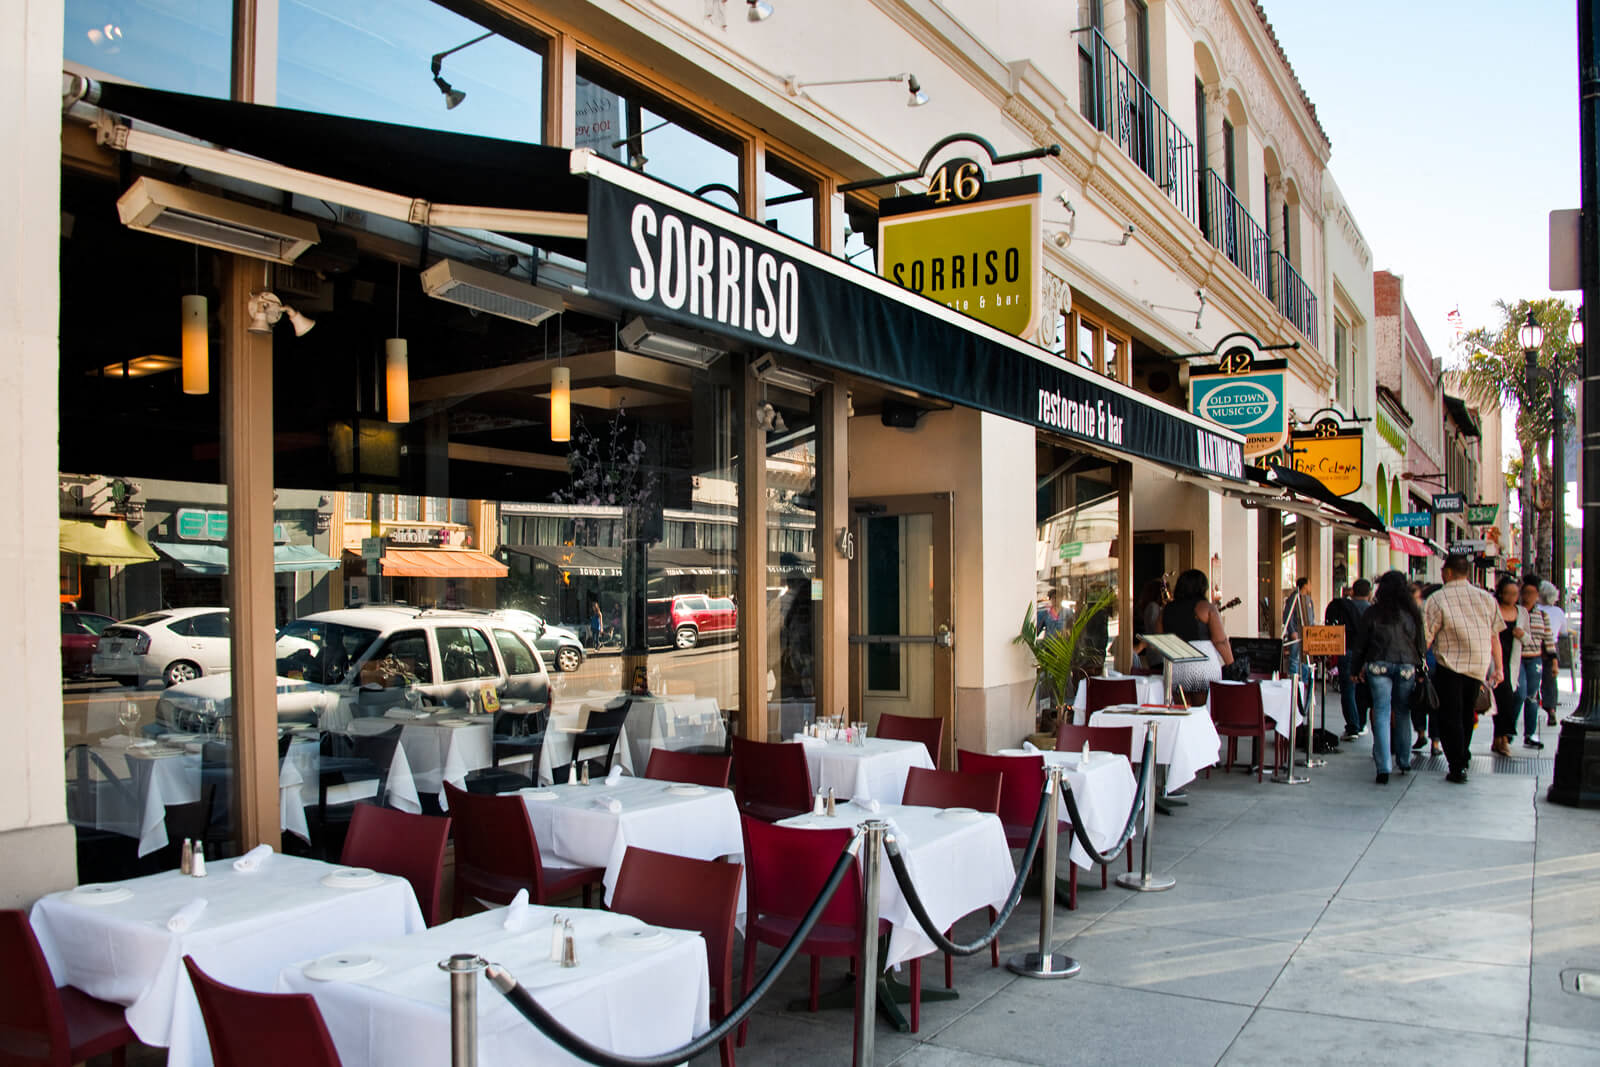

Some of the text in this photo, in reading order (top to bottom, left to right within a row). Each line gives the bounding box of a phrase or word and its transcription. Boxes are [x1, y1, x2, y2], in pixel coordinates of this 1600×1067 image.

[926, 163, 980, 204] 46
[630, 203, 799, 346] SORRISO
[893, 247, 1019, 293] SORRISO
[996, 293, 1019, 307] bar
[1218, 353, 1251, 375] 42
[1210, 393, 1265, 405] OLD TOWN
[1038, 389, 1124, 446] restorante & bar
[1212, 406, 1263, 417] MUSIC CO.
[1315, 422, 1338, 438] 38
[1434, 498, 1460, 509] VANS
[841, 532, 854, 560] 46
